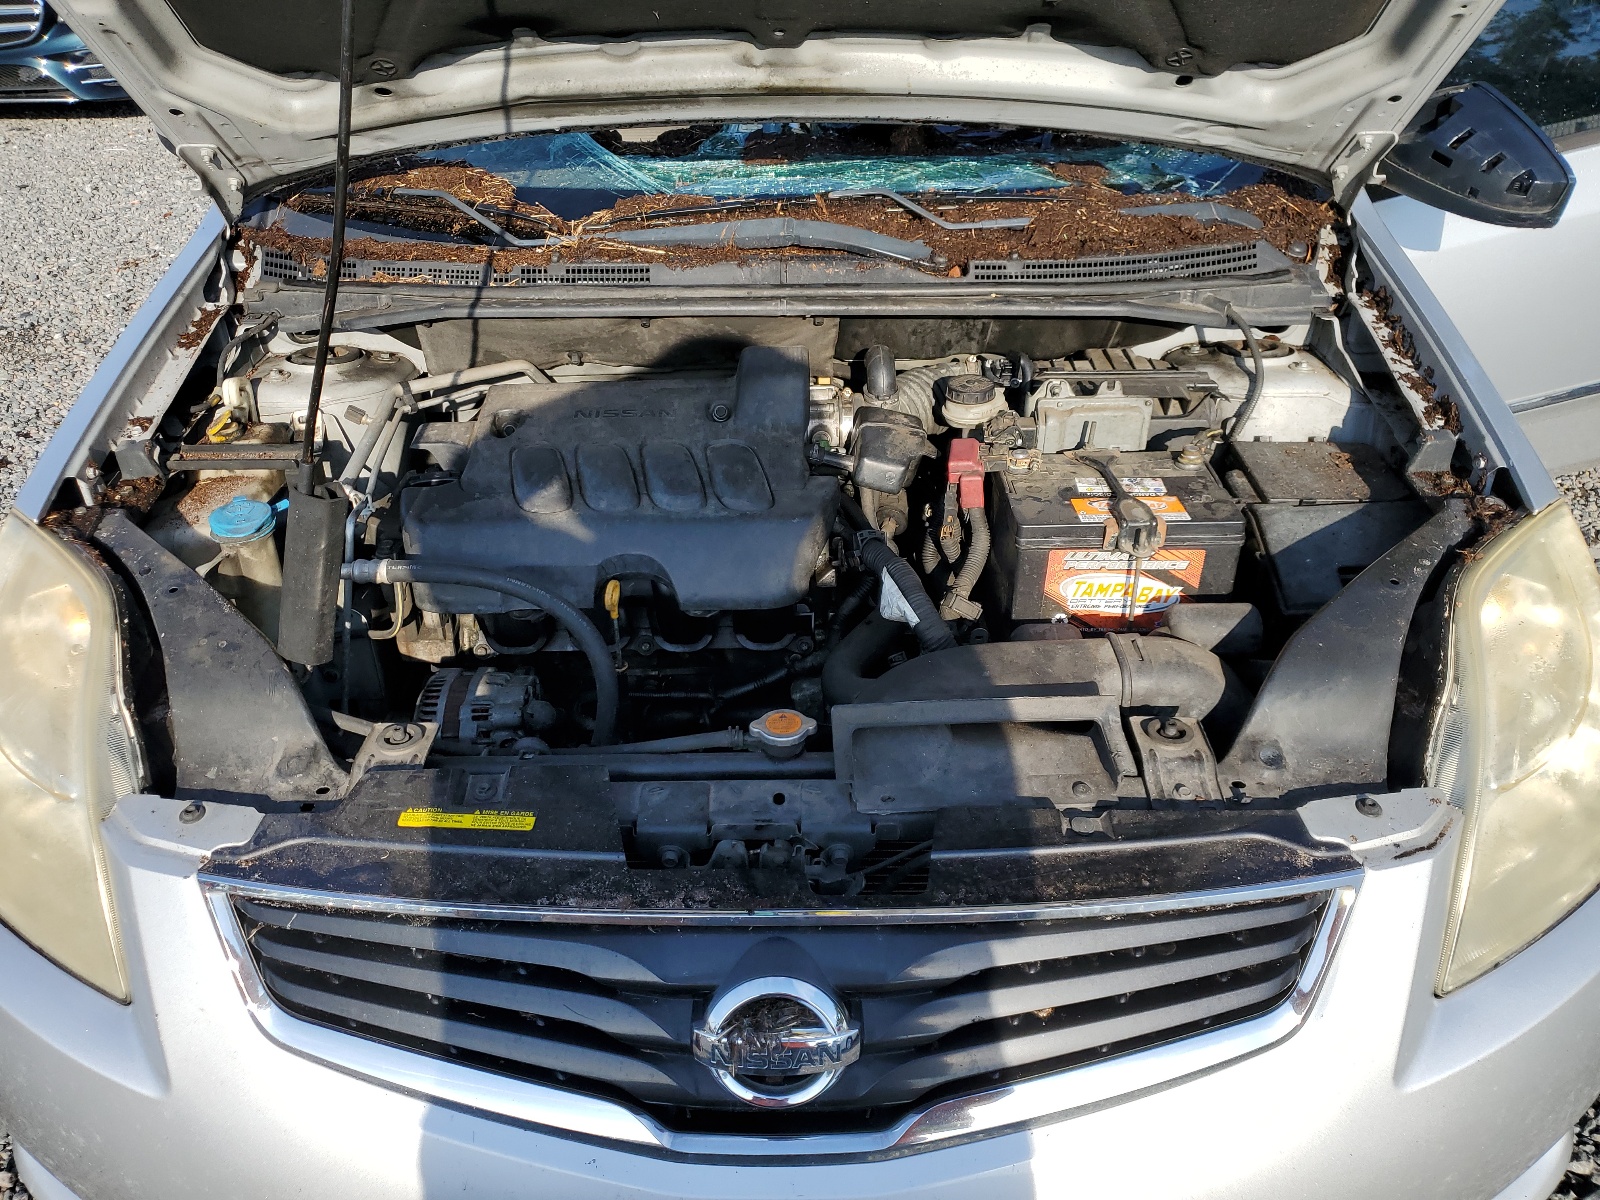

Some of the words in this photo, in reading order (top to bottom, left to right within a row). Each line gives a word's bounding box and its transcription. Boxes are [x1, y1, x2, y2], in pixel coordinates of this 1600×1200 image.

[573, 408, 676, 419] NISSAN
[1072, 581, 1135, 598] TAMPA
[1136, 586, 1179, 604] BAY
[710, 1041, 842, 1070] NISSAN
